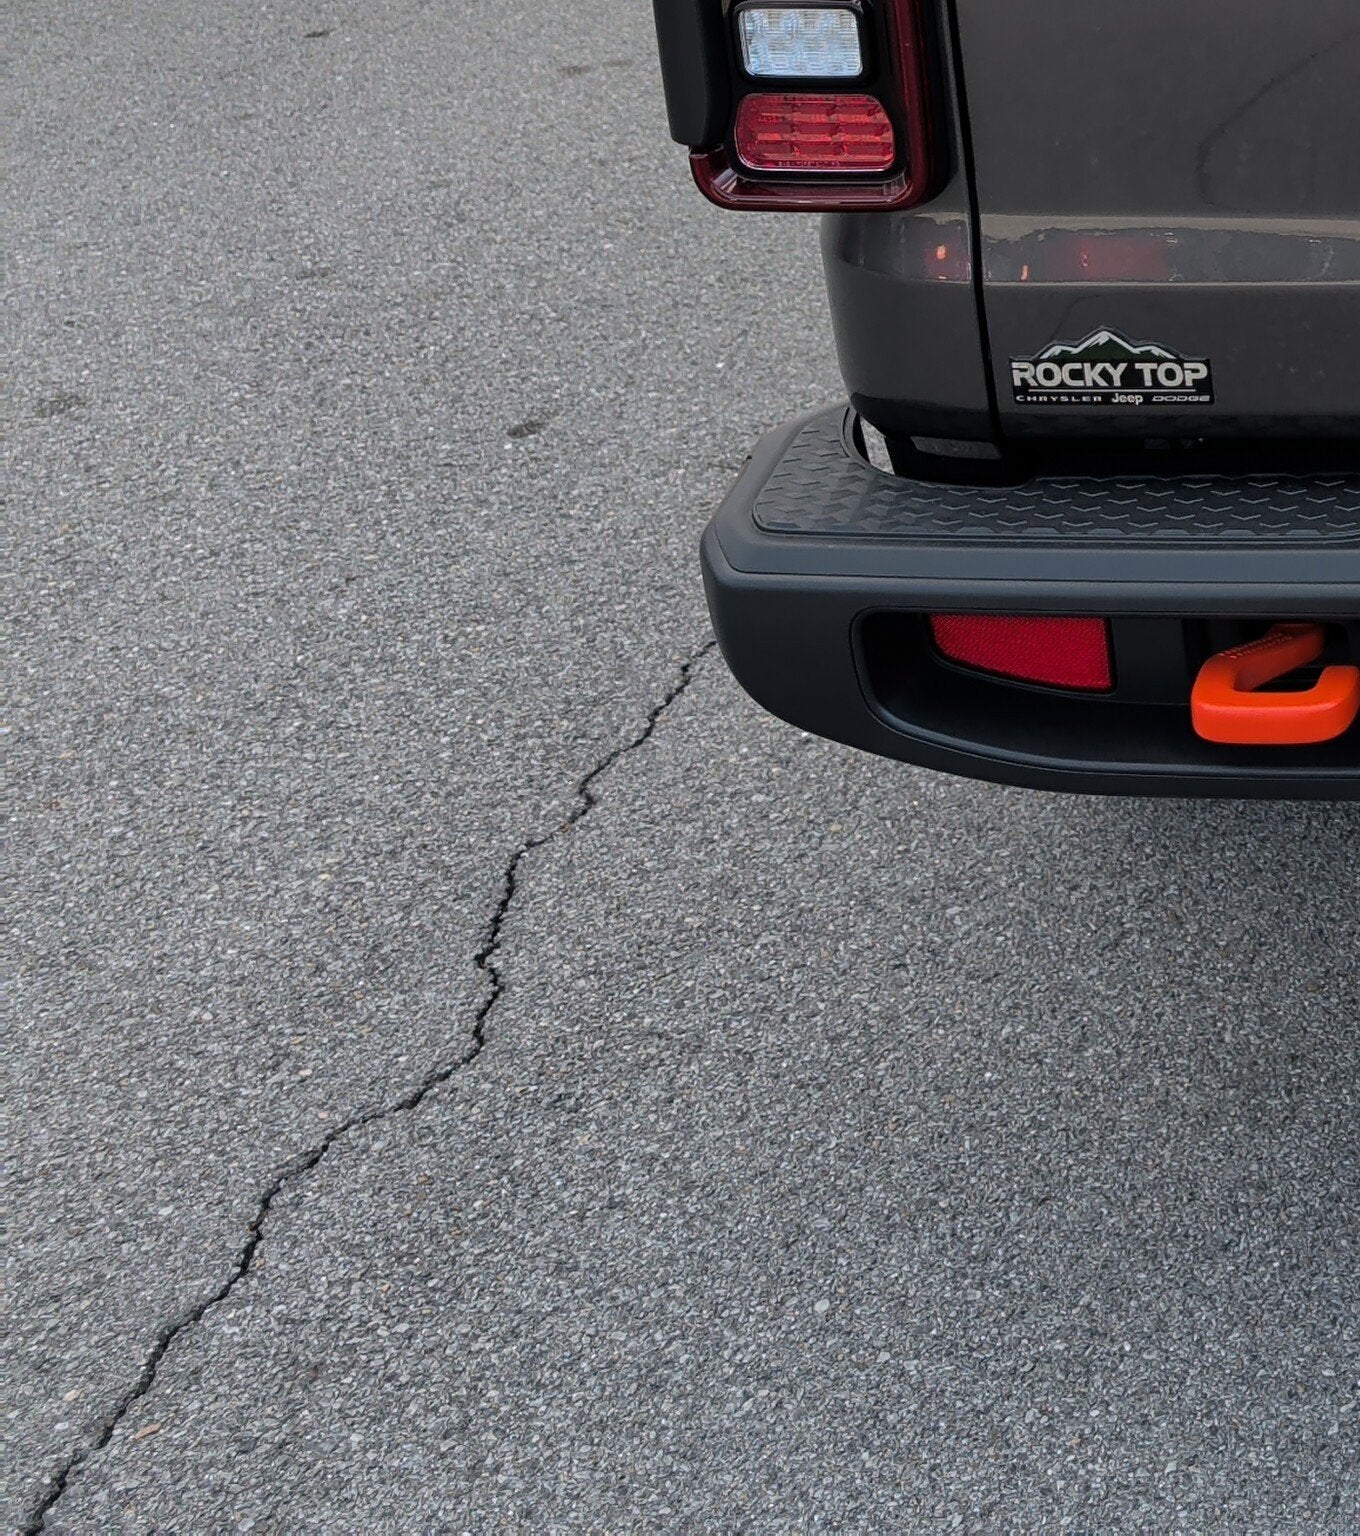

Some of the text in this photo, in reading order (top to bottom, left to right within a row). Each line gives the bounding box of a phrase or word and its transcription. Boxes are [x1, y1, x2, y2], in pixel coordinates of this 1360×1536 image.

[1012, 362, 1208, 387] ROCKY TOP
[1111, 393, 1144, 405] Jeep
